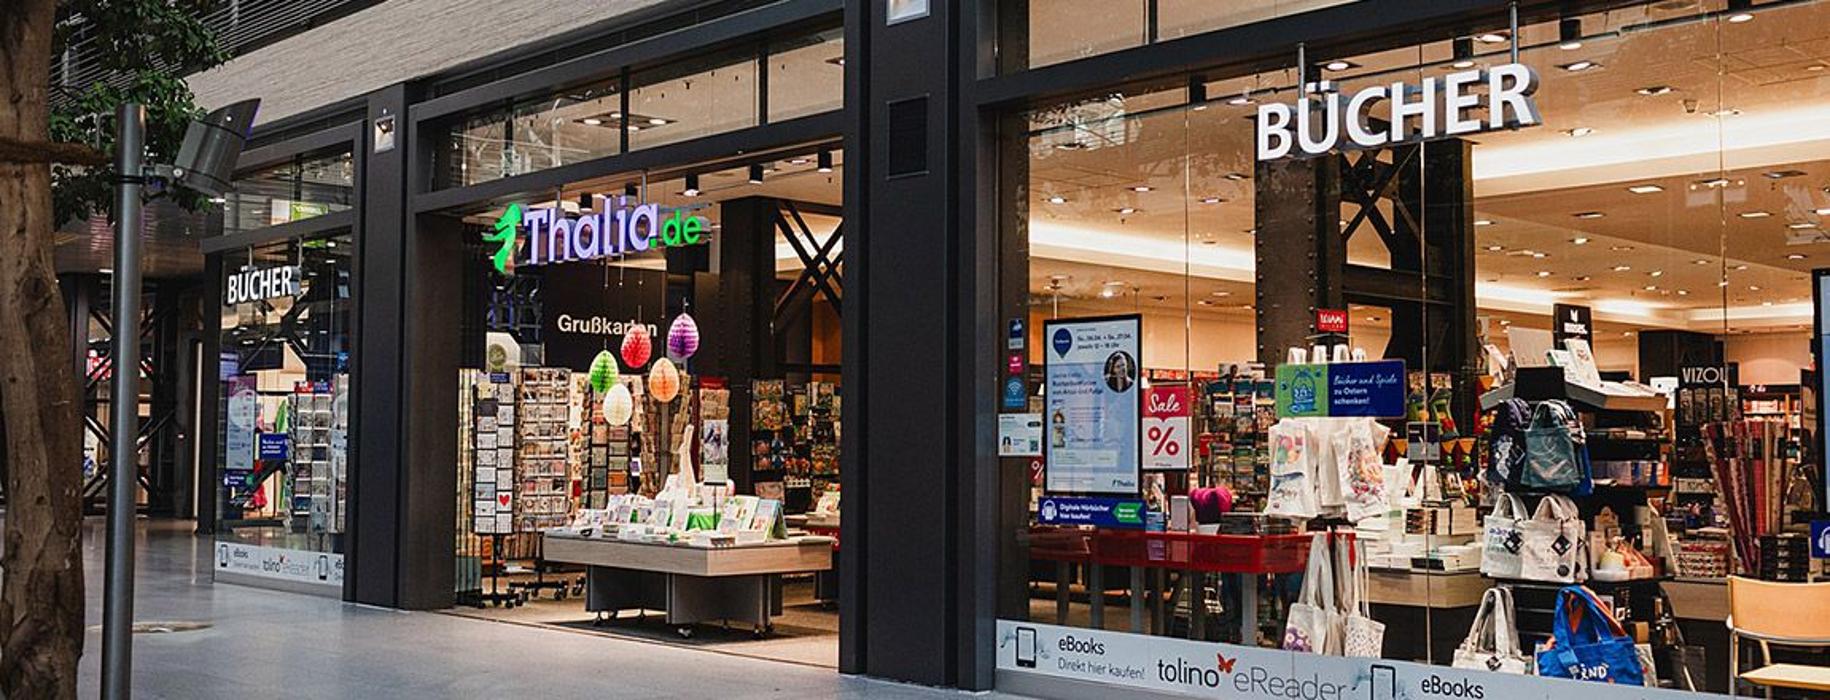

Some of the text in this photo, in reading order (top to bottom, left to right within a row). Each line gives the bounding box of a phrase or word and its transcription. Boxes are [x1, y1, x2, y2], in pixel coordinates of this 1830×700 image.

[1257, 64, 1535, 161] BÜCHER
[226, 265, 293, 305] BÜCHER
[1359, 375, 1374, 384] und
[1375, 374, 1398, 388] Spiele
[1148, 393, 1181, 413] Sale
[1334, 396, 1370, 405] schenken!
[1148, 425, 1180, 456] %
[1058, 635, 1105, 655] eBooks
[1057, 657, 1145, 680] Direkt hier kaufen!
[1157, 658, 1348, 700] tolino eReader
[1421, 674, 1484, 699] eBooks
